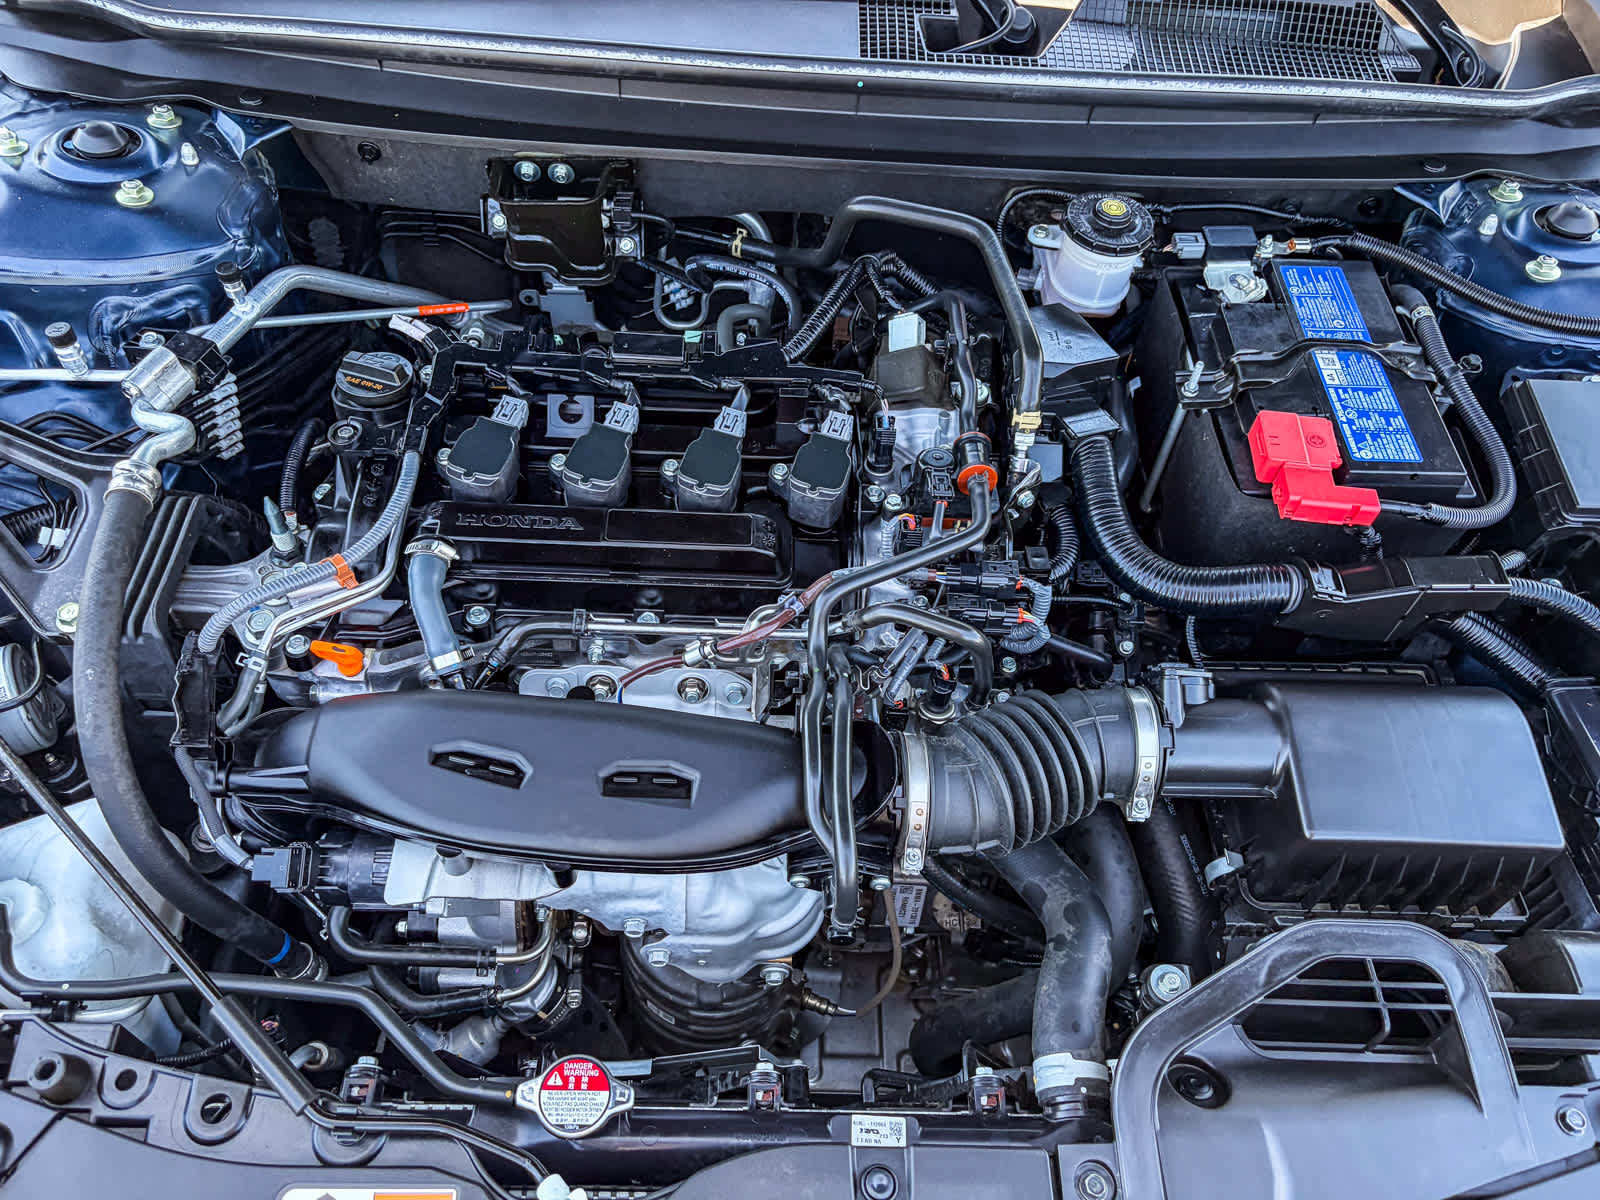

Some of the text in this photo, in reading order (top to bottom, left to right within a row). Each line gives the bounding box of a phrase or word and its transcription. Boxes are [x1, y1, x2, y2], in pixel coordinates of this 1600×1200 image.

[345, 376, 384, 390] SAE 0W-20
[456, 513, 584, 530] HONDA
[896, 1136, 901, 1144] Y
